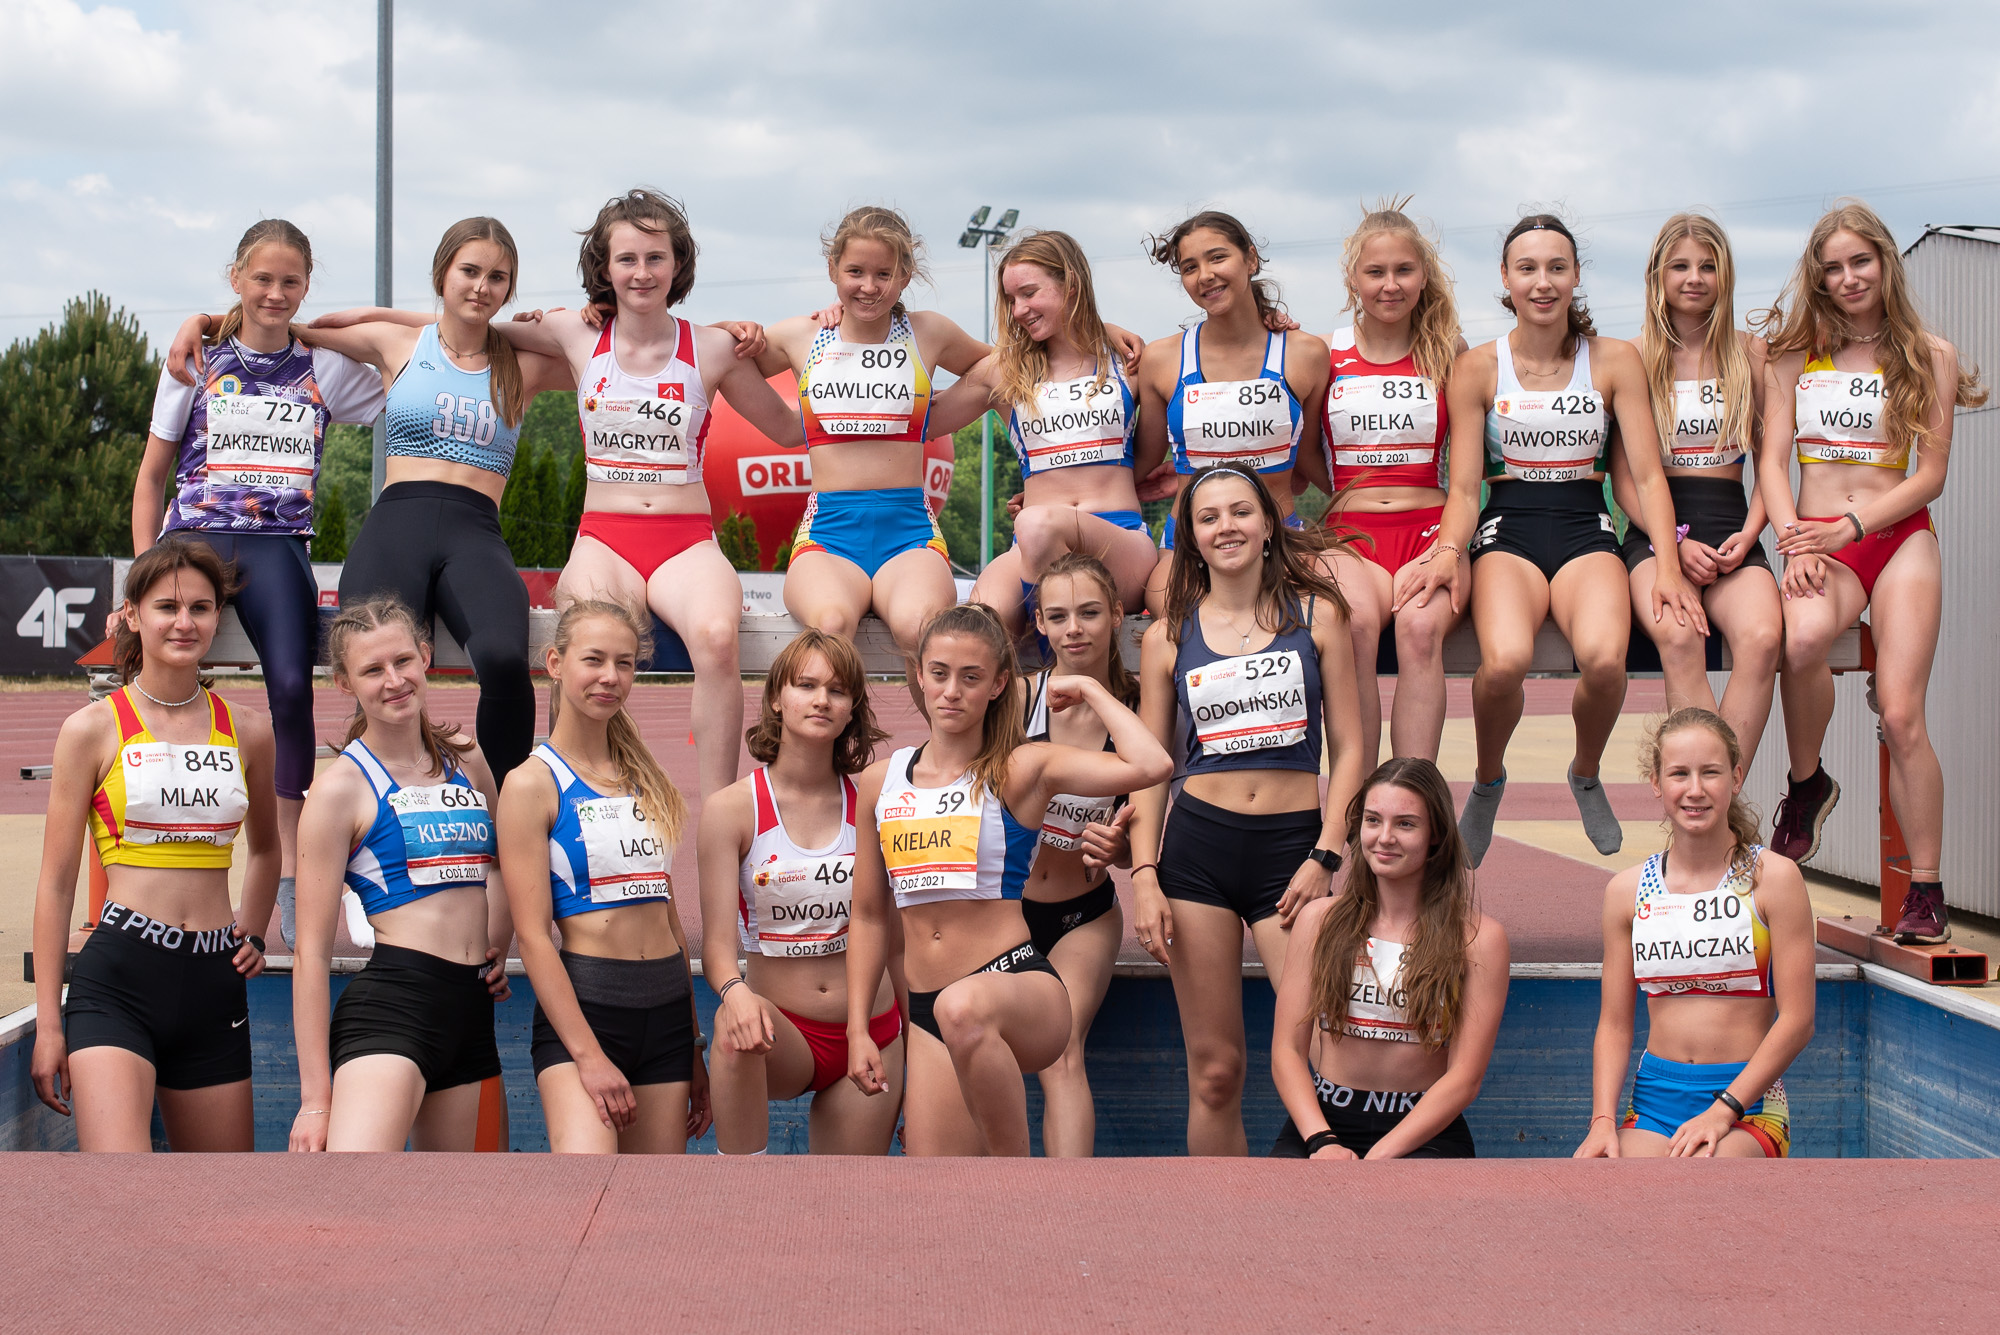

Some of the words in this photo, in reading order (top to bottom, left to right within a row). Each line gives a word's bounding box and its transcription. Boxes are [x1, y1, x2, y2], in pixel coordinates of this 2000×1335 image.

[861, 349, 907, 368] 809
[271, 384, 314, 398] DECATHLON
[812, 382, 910, 400] GAWLICKA
[1239, 384, 1282, 405] 854
[1382, 381, 1428, 400] 831
[264, 401, 306, 423] 727
[637, 400, 682, 426] 466
[1551, 395, 1596, 414] 428
[432, 392, 498, 447] 358
[831, 420, 859, 432] ŁÓDŹ
[862, 423, 886, 433] 2021
[1022, 408, 1121, 437] POLKOWSKA
[1202, 420, 1275, 438] RUDNIK
[1351, 413, 1415, 431] PIELKA
[1820, 408, 1873, 429] WÓJS
[212, 433, 313, 455] ZAKRZEWSKA
[593, 430, 681, 451] MAGRYTA
[1503, 429, 1600, 447] JAWORSKA
[1050, 450, 1078, 465] ŁÓDŹ
[1080, 449, 1104, 461] 2021
[1357, 452, 1383, 463] ŁÓDŹ
[1386, 453, 1409, 463] 2021
[1703, 454, 1725, 465] 2021
[1848, 450, 1872, 460] 2021
[233, 471, 262, 484] ŁÓDŹ
[266, 474, 289, 485] 2021
[607, 468, 634, 481] ŁÓDŹ
[638, 472, 662, 482] 2021
[745, 461, 812, 489] ORL
[1523, 468, 1552, 480] ŁÓDŹ
[1555, 469, 1577, 480] 2021
[16, 587, 96, 648] 4F
[1245, 655, 1291, 681] 529
[1196, 688, 1303, 722] ODOLIŃSKA
[1225, 735, 1256, 751] ŁÓDŹ
[1258, 734, 1284, 747] 2021
[184, 750, 234, 772] 845
[161, 787, 220, 807] MLAK
[441, 787, 482, 808] 661
[935, 791, 965, 815] 59
[885, 807, 914, 818] ORLEN
[417, 822, 488, 844] KLESZNO
[893, 829, 952, 853] KIELAR
[1050, 836, 1075, 849] 2021
[620, 837, 665, 858] LACH
[899, 875, 919, 891] ÓDŹ
[921, 876, 945, 887] 2021
[771, 900, 852, 921] DWOJA
[1693, 895, 1741, 922] 810
[121, 911, 185, 950] PRO
[786, 942, 819, 956] ŁÓDŹ
[821, 938, 846, 954] 2021
[1011, 944, 1034, 965] PRO
[1635, 935, 1752, 961] RATAJCZAK
[1363, 1090, 1427, 1113] NIK
